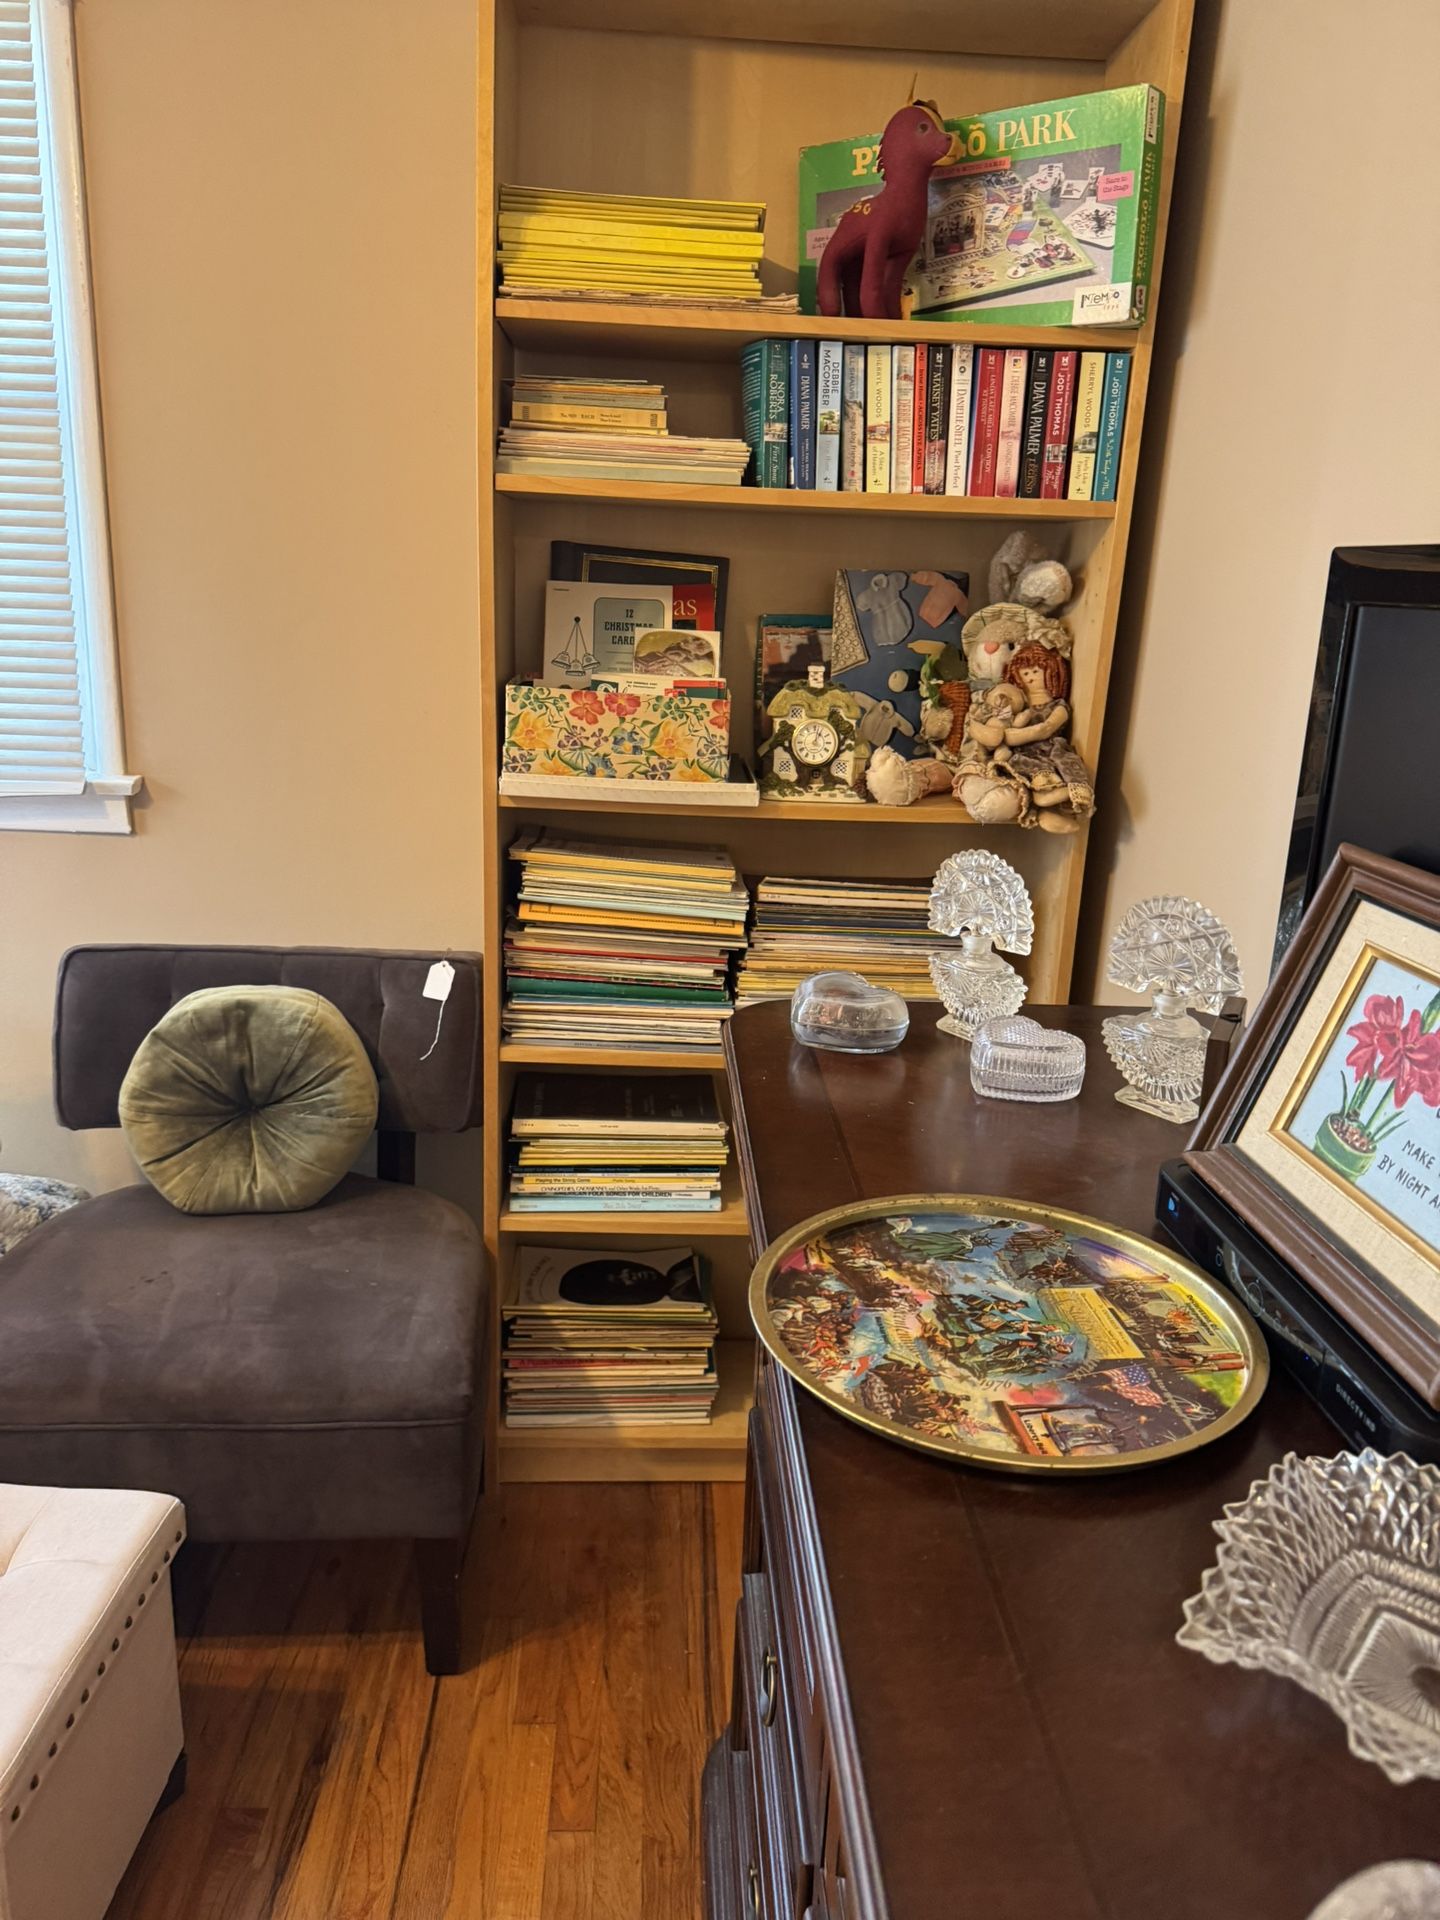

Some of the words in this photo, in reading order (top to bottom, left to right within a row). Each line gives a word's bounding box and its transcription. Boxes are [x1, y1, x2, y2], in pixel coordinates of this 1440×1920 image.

[997, 109, 1078, 153] PARK
[801, 376, 810, 399] DIANA
[821, 349, 832, 406] MACOMBER
[831, 361, 840, 394] DEBBIE
[931, 371, 943, 409] MAISEY
[1010, 375, 1021, 394] DEBBIE
[1056, 372, 1066, 394] JODI
[1086, 361, 1096, 394] SHERRYL
[1111, 376, 1120, 397] JODI
[769, 374, 778, 420] ROBERTS
[777, 381, 785, 413] NORA
[875, 388, 883, 418] WOODS
[897, 398, 910, 423] DEBBIE
[955, 388, 968, 424] DANIELLE
[1007, 396, 1019, 428] MACOMBER
[1032, 381, 1047, 414] DIANA
[1084, 397, 1093, 428] WOODS
[800, 401, 810, 430] PALMER
[930, 410, 939, 440] YATES
[1052, 397, 1063, 436] THOMAS
[1107, 400, 1117, 437] THOMAS
[953, 424, 965, 448] STEEL
[1027, 416, 1043, 455] PALMER
[771, 446, 779, 462] First
[984, 443, 993, 474] COWBOY
[952, 465, 961, 489] Perfect
[1026, 458, 1038, 494] LEGEND
[1074, 461, 1083, 480] Family
[625, 609, 634, 618] 12
[611, 635, 635, 645] CARO
[1401, 1139, 1436, 1170] MAKE
[1377, 1153, 1396, 1174] BY
[1395, 1167, 1431, 1200] NIGHT
[980, 1380, 1012, 1392] 1976
[1023, 1419, 1039, 1442] Liberty
[1037, 1442, 1049, 1455] Bell
